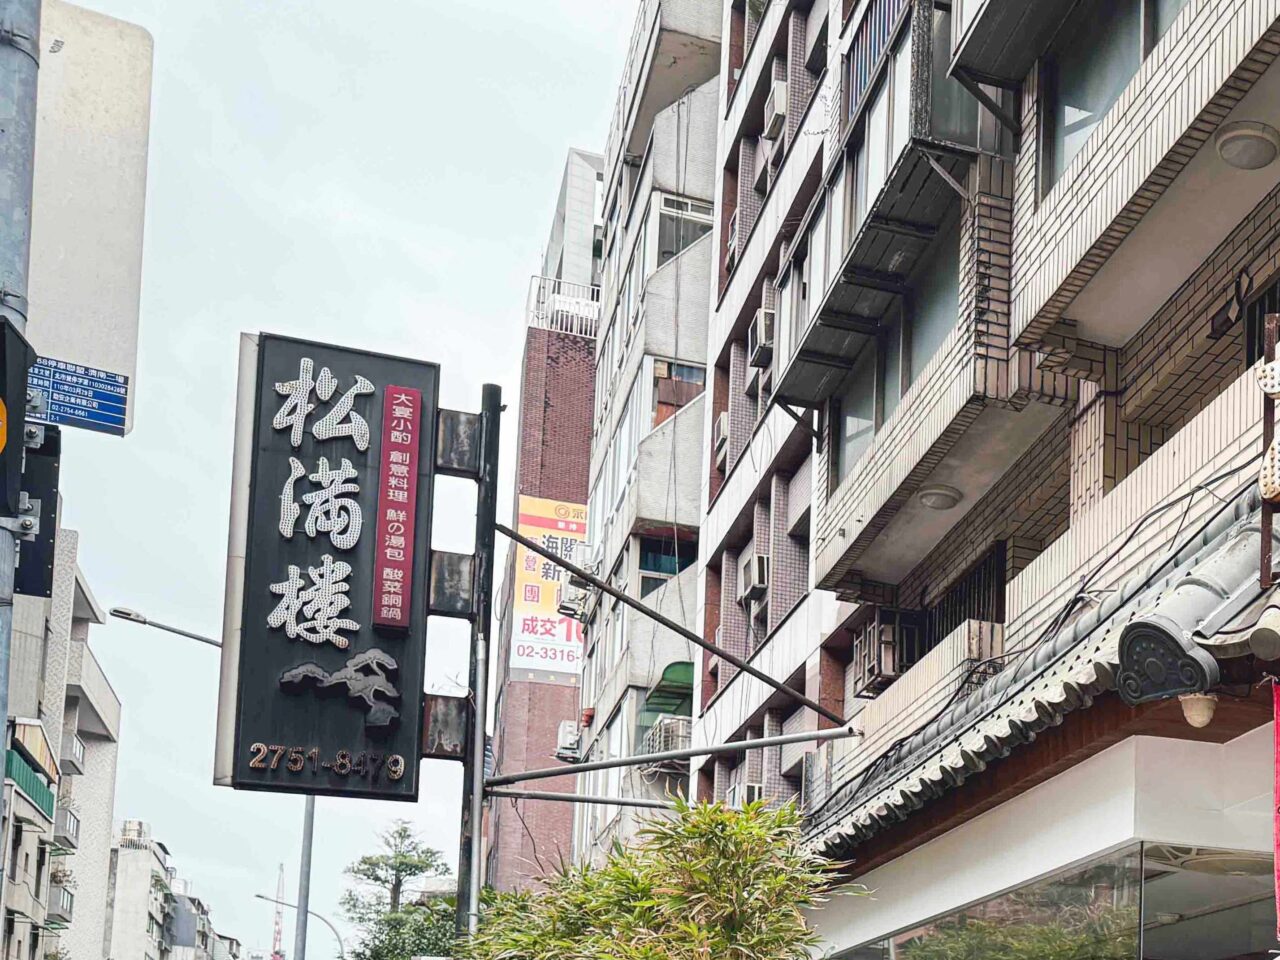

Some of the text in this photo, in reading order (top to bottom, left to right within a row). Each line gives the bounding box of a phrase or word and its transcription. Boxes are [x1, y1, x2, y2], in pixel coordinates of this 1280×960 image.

[387, 450, 410, 503] 創意料理
[384, 508, 407, 561] 鮮の湯包
[541, 534, 586, 562] 海關
[521, 615, 557, 638] 成交
[516, 643, 583, 663] 02-3316-
[250, 741, 405, 782] 2751-8479
